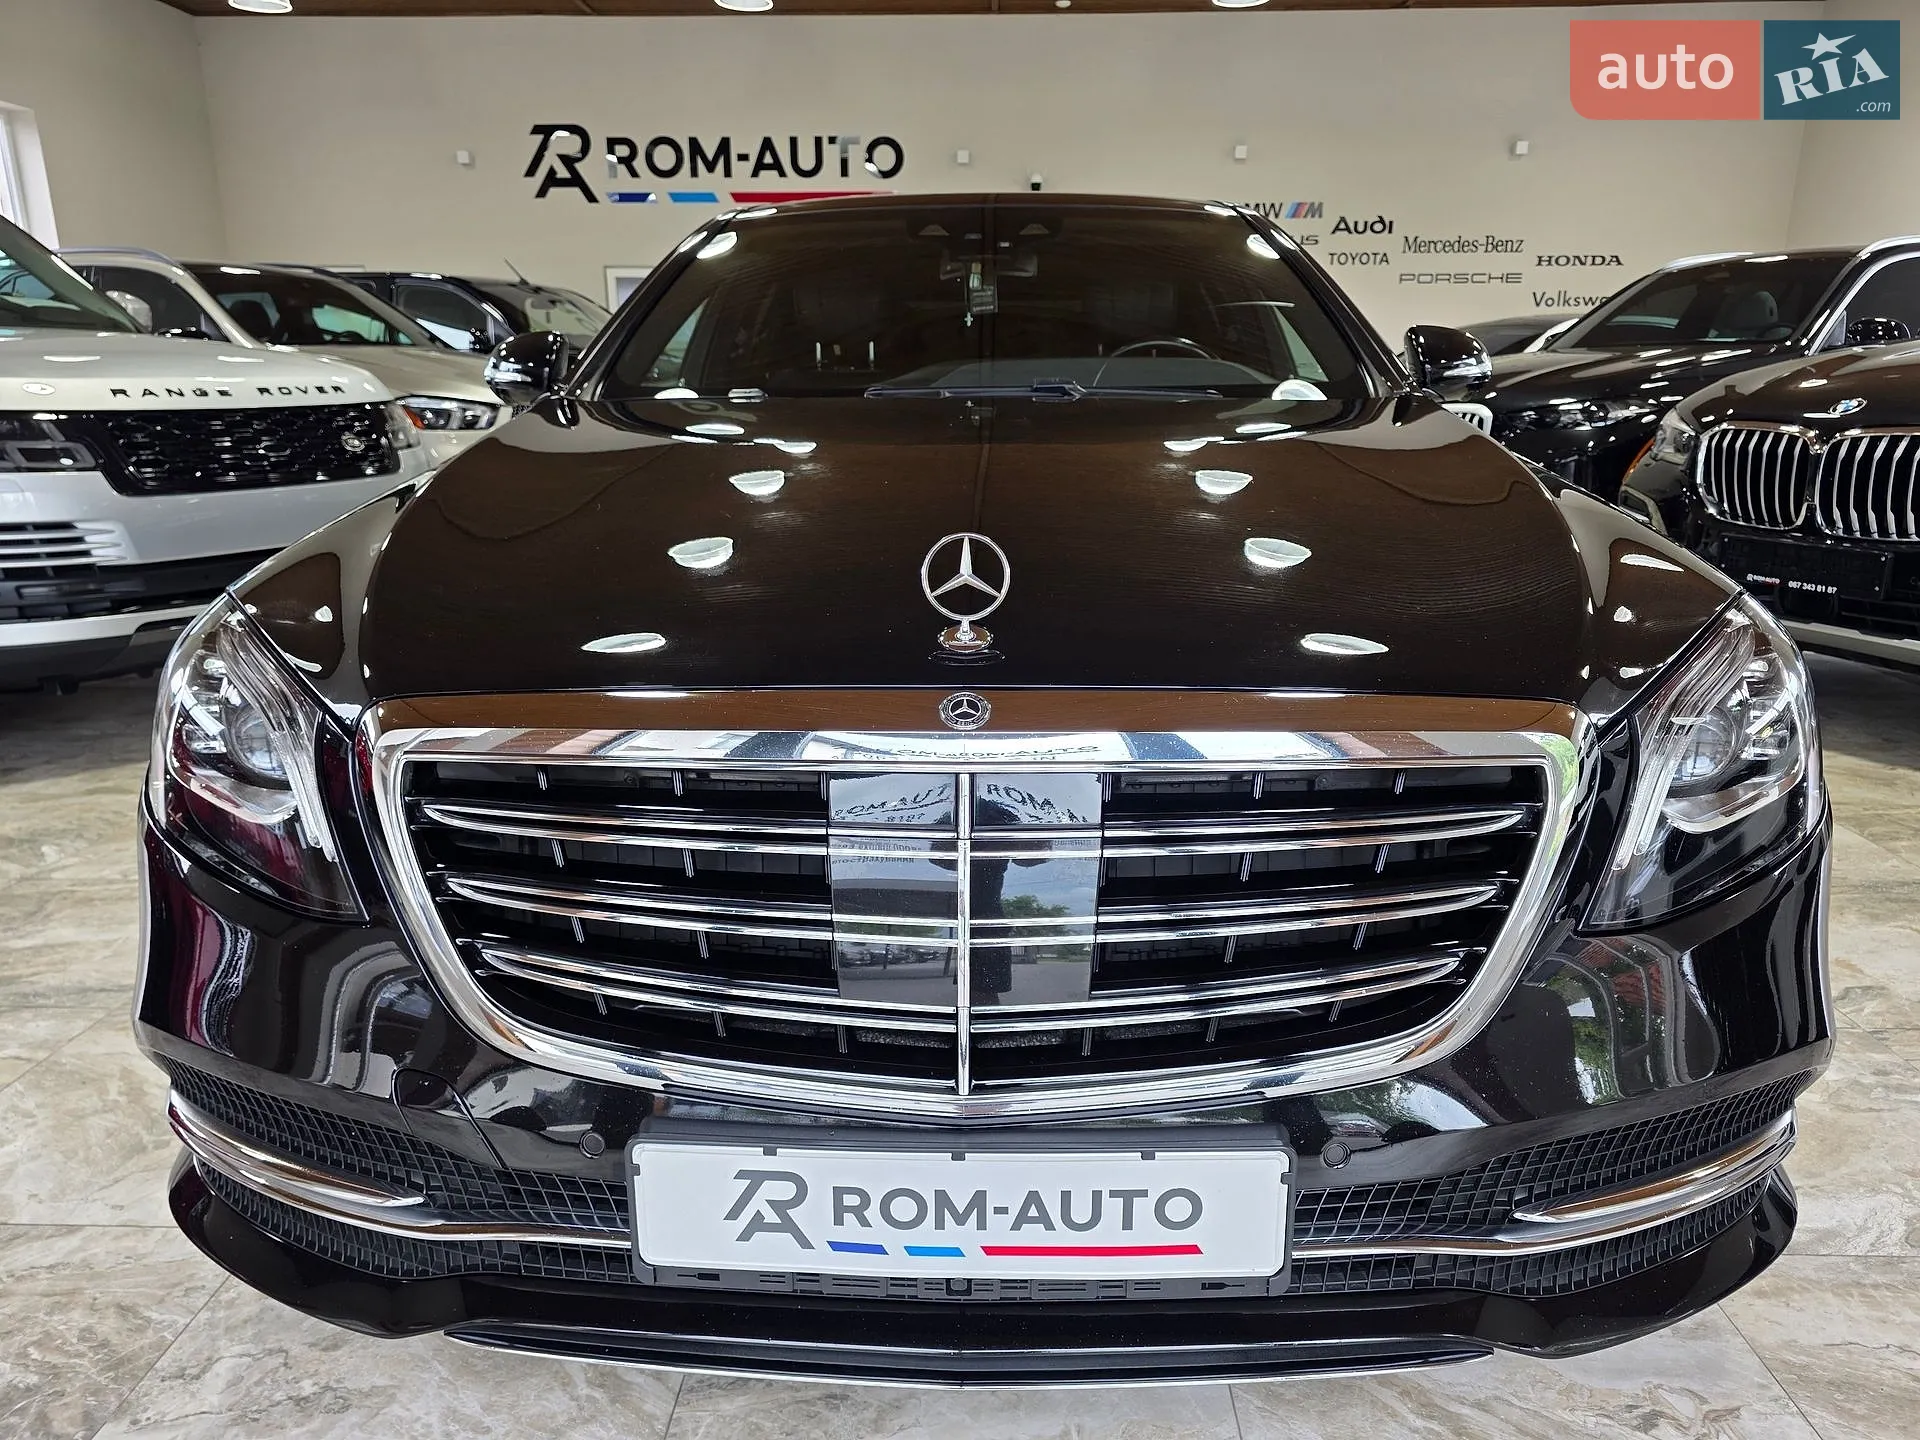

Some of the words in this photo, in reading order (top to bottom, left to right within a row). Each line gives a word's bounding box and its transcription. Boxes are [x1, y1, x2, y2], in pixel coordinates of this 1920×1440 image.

[606, 135, 905, 179] ROM-AUTO
[1331, 215, 1394, 235] Audi
[1402, 234, 1525, 255] Mercedes-Benz
[1329, 252, 1390, 266] TOYOTA
[1535, 255, 1624, 267] HONDA
[1399, 272, 1523, 285] PORSCHE
[109, 387, 233, 398] RANGE
[256, 384, 346, 396] ROVER
[832, 1185, 1204, 1232] ROM-AUTO
